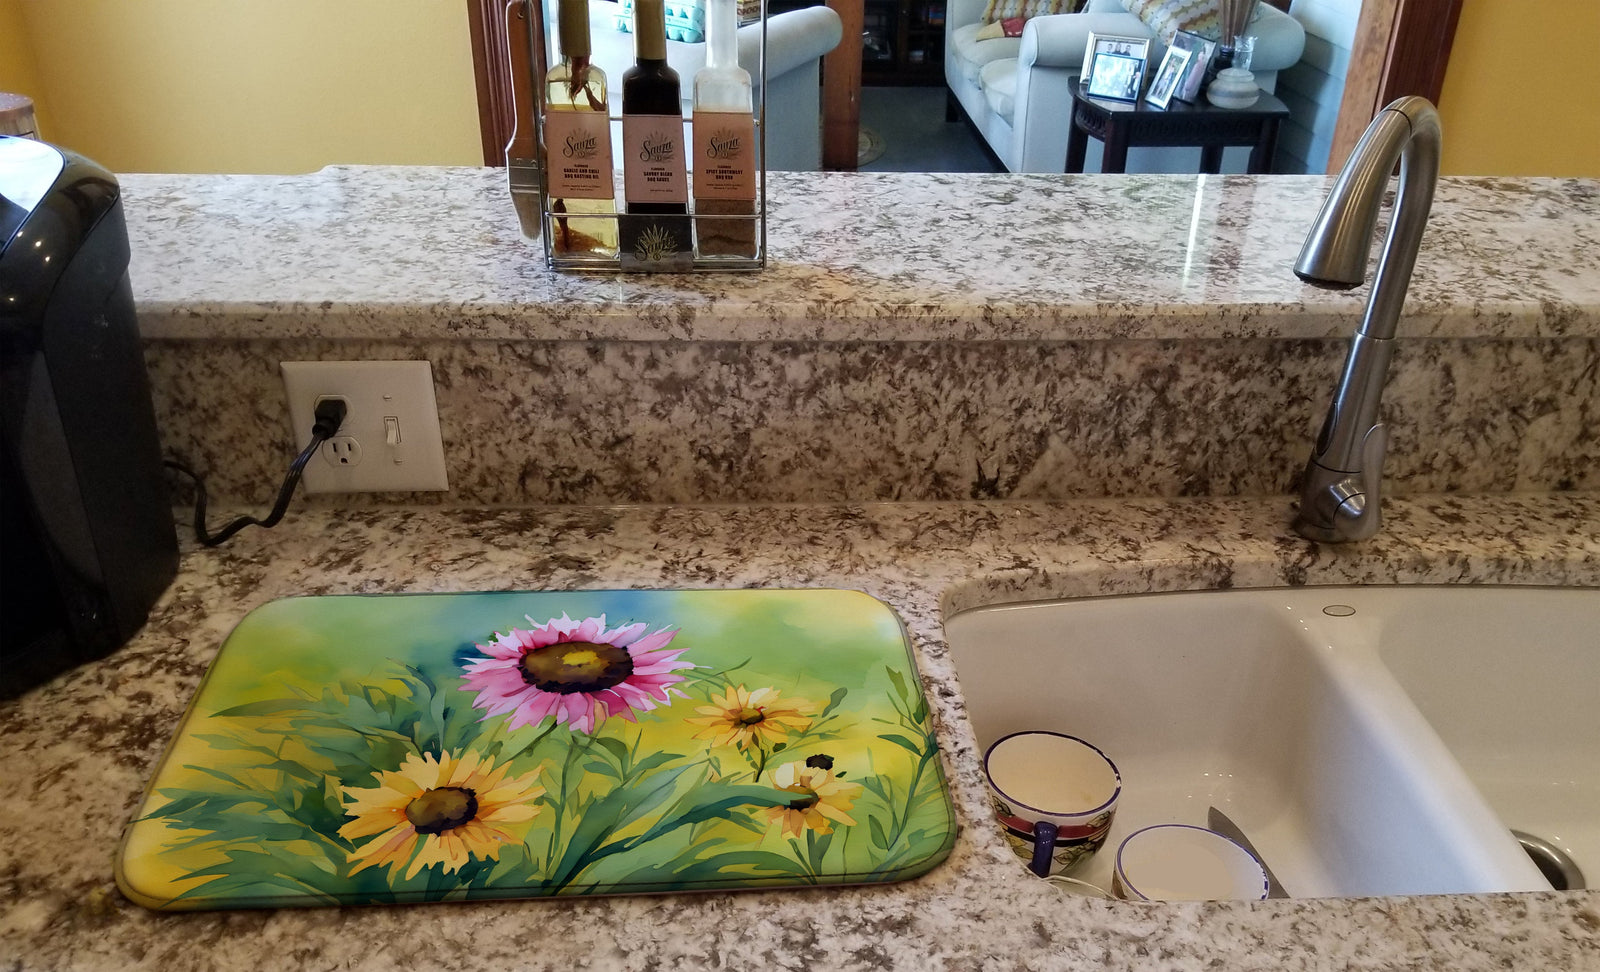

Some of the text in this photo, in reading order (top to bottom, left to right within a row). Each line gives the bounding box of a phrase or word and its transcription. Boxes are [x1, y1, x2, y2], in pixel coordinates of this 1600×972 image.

[562, 135, 597, 158] Sauza
[640, 140, 673, 162] Sauza
[706, 136, 740, 159] Sauza
